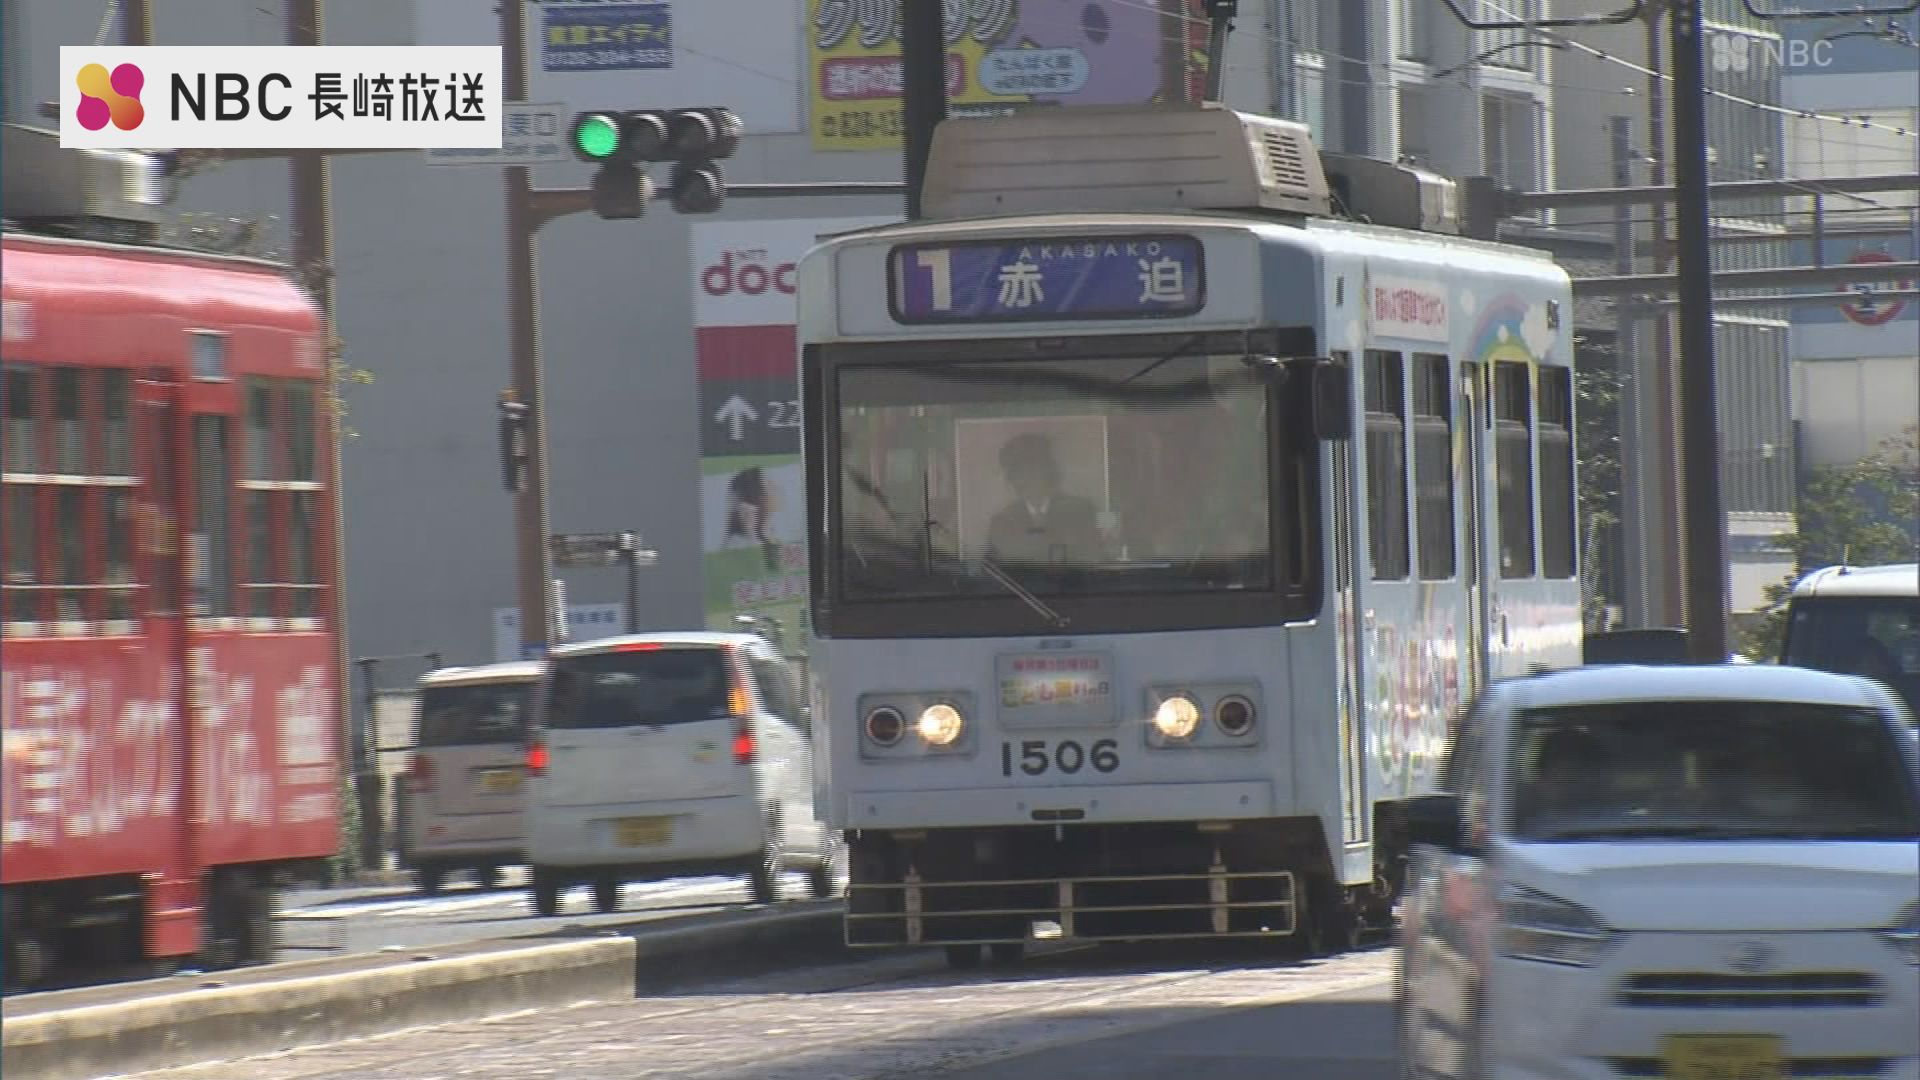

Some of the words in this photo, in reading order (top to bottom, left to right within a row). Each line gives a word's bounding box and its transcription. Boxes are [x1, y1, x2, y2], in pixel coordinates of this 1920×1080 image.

[1019, 243, 1162, 260] AKASAKO
[915, 249, 953, 312] 1
[1001, 739, 1120, 778] 1506
